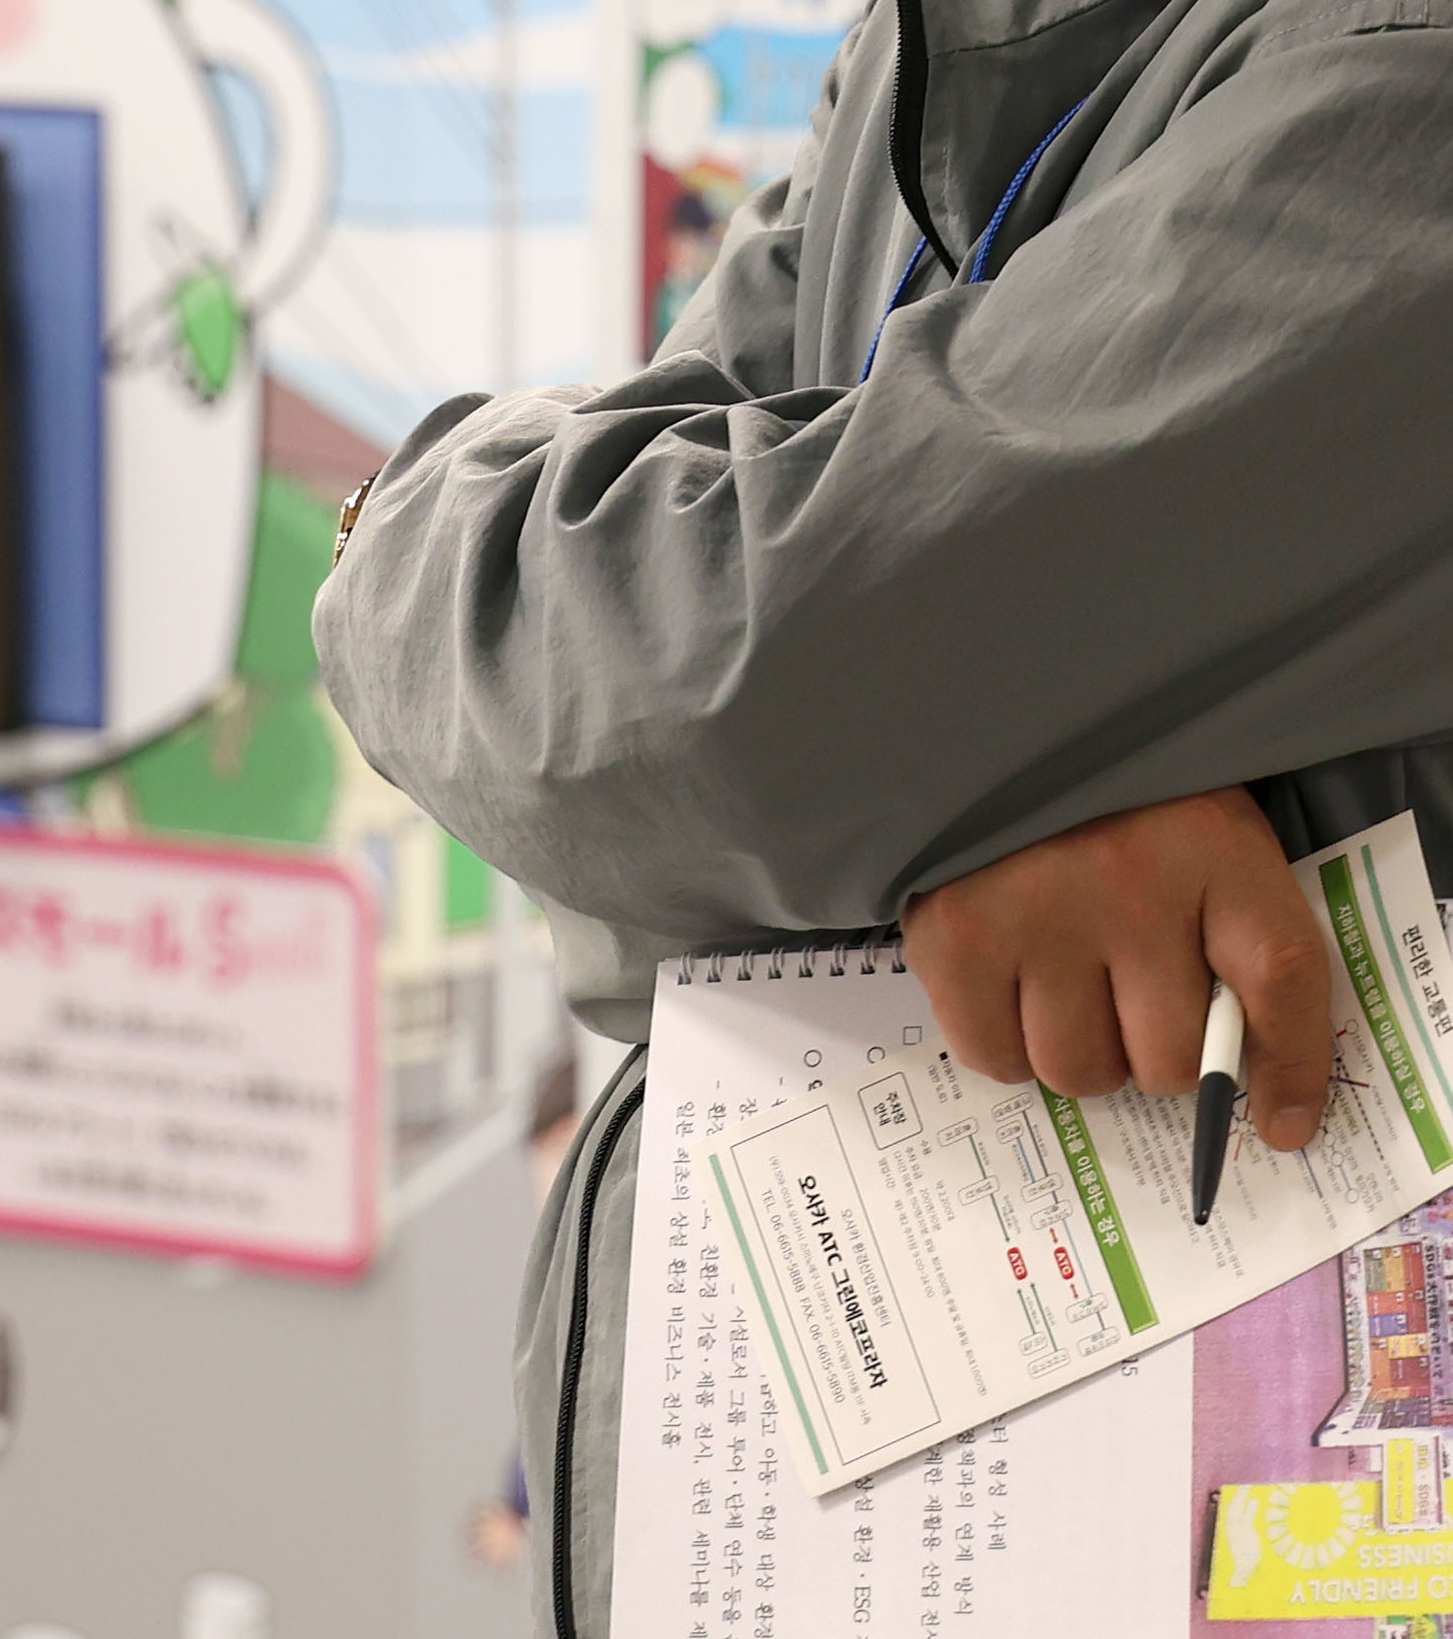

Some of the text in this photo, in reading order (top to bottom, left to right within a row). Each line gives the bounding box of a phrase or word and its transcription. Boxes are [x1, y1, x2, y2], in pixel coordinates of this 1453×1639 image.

[1399, 924, 1435, 979] 편리한
[1333, 902, 1369, 959] 지하철과
[1377, 1018, 1415, 1082] 이용하실
[1401, 1082, 1428, 1114] 경우
[739, 1098, 757, 1120] 장
[872, 1102, 892, 1126] 안내
[883, 1090, 907, 1125] 주차장
[1051, 1096, 1121, 1248] 자동차를 이용하는 경우
[661, 1100, 695, 1448] 일본 최초의 상설 환경 비즈니스 전시홀
[699, 1245, 719, 1298] 친환경
[839, 1208, 893, 1328] 오사카 환경산업진흥센터
[1007, 1249, 1027, 1277] ATC
[1054, 1249, 1073, 1276] ATC
[795, 1174, 889, 1390] 오사카 ATC 그린에코프라자
[768, 1213, 807, 1293] 06-6615-5888
[807, 1322, 847, 1404] 06-6615-5890
[727, 1306, 749, 1378] 시설로서
[726, 1389, 746, 1426] 그룹
[693, 1422, 713, 1464] 전시,
[921, 1445, 945, 1482] 계한
[988, 1458, 1008, 1496] 형성
[691, 1478, 711, 1514] 관련
[853, 1473, 875, 1511] 상설
[921, 1496, 942, 1550] 재활용
[954, 1522, 973, 1561] 연계
[987, 1512, 1007, 1550] 사례
[689, 1531, 710, 1606] 세미나를
[723, 1539, 743, 1577] 연수
[755, 1553, 775, 1591] 대상
[921, 1563, 941, 1598] 산업
[953, 1576, 973, 1614] 방식
[1291, 1577, 1419, 1602] FRIENDLY
[721, 1586, 741, 1624] 등을
[753, 1602, 773, 1638] 환경
